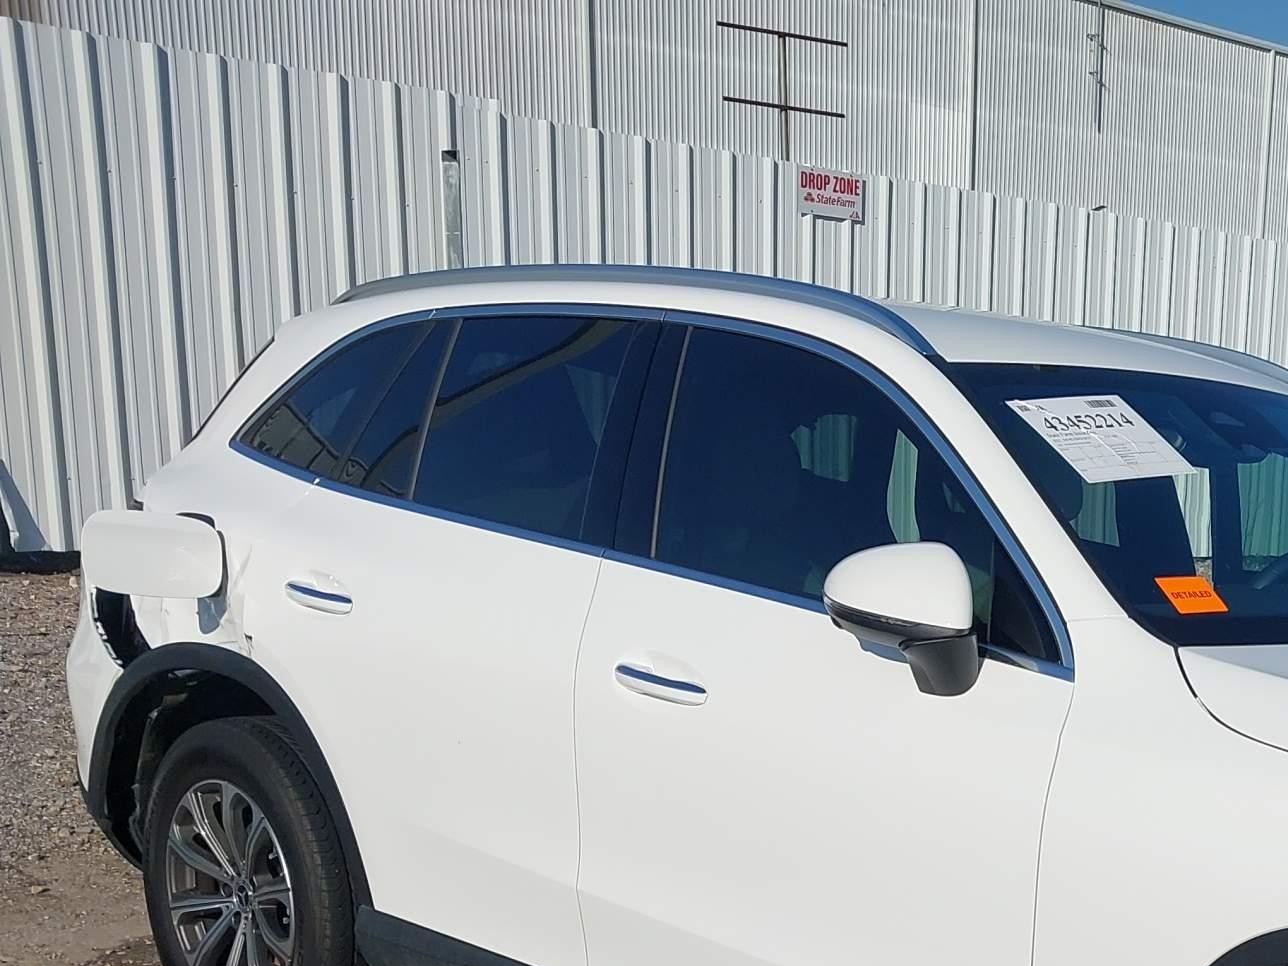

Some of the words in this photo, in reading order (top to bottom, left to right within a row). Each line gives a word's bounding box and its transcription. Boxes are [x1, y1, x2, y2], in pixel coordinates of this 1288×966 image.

[800, 171, 831, 192] DROP
[832, 175, 860, 197] ZONE
[1042, 412, 1134, 432] 43452214
[1170, 590, 1212, 600] DETAILED
